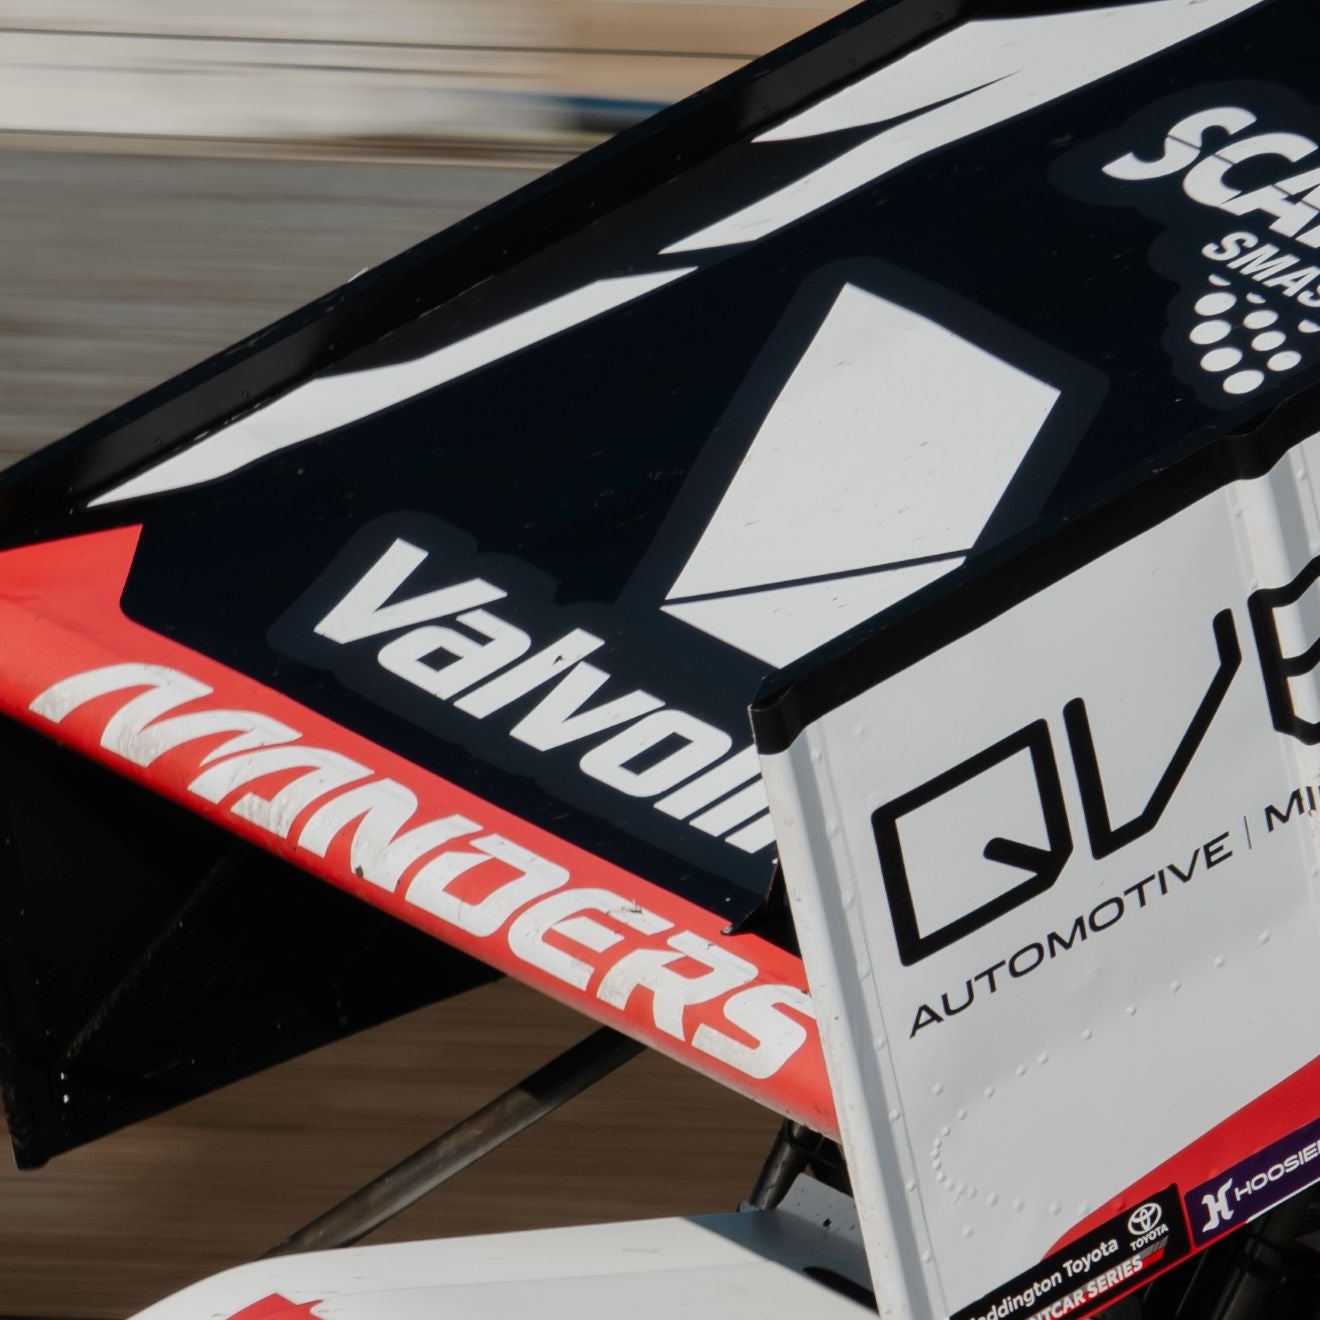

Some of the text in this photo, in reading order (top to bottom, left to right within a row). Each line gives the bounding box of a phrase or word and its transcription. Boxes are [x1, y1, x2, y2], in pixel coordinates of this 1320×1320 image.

[314, 539, 778, 855] Valvolin
[910, 831, 1232, 1040] AUTOMOTIVE
[1063, 1236, 1120, 1279] Toyota
[1130, 1223, 1169, 1252] TOYOTA
[1087, 1254, 1145, 1298] SERIES
